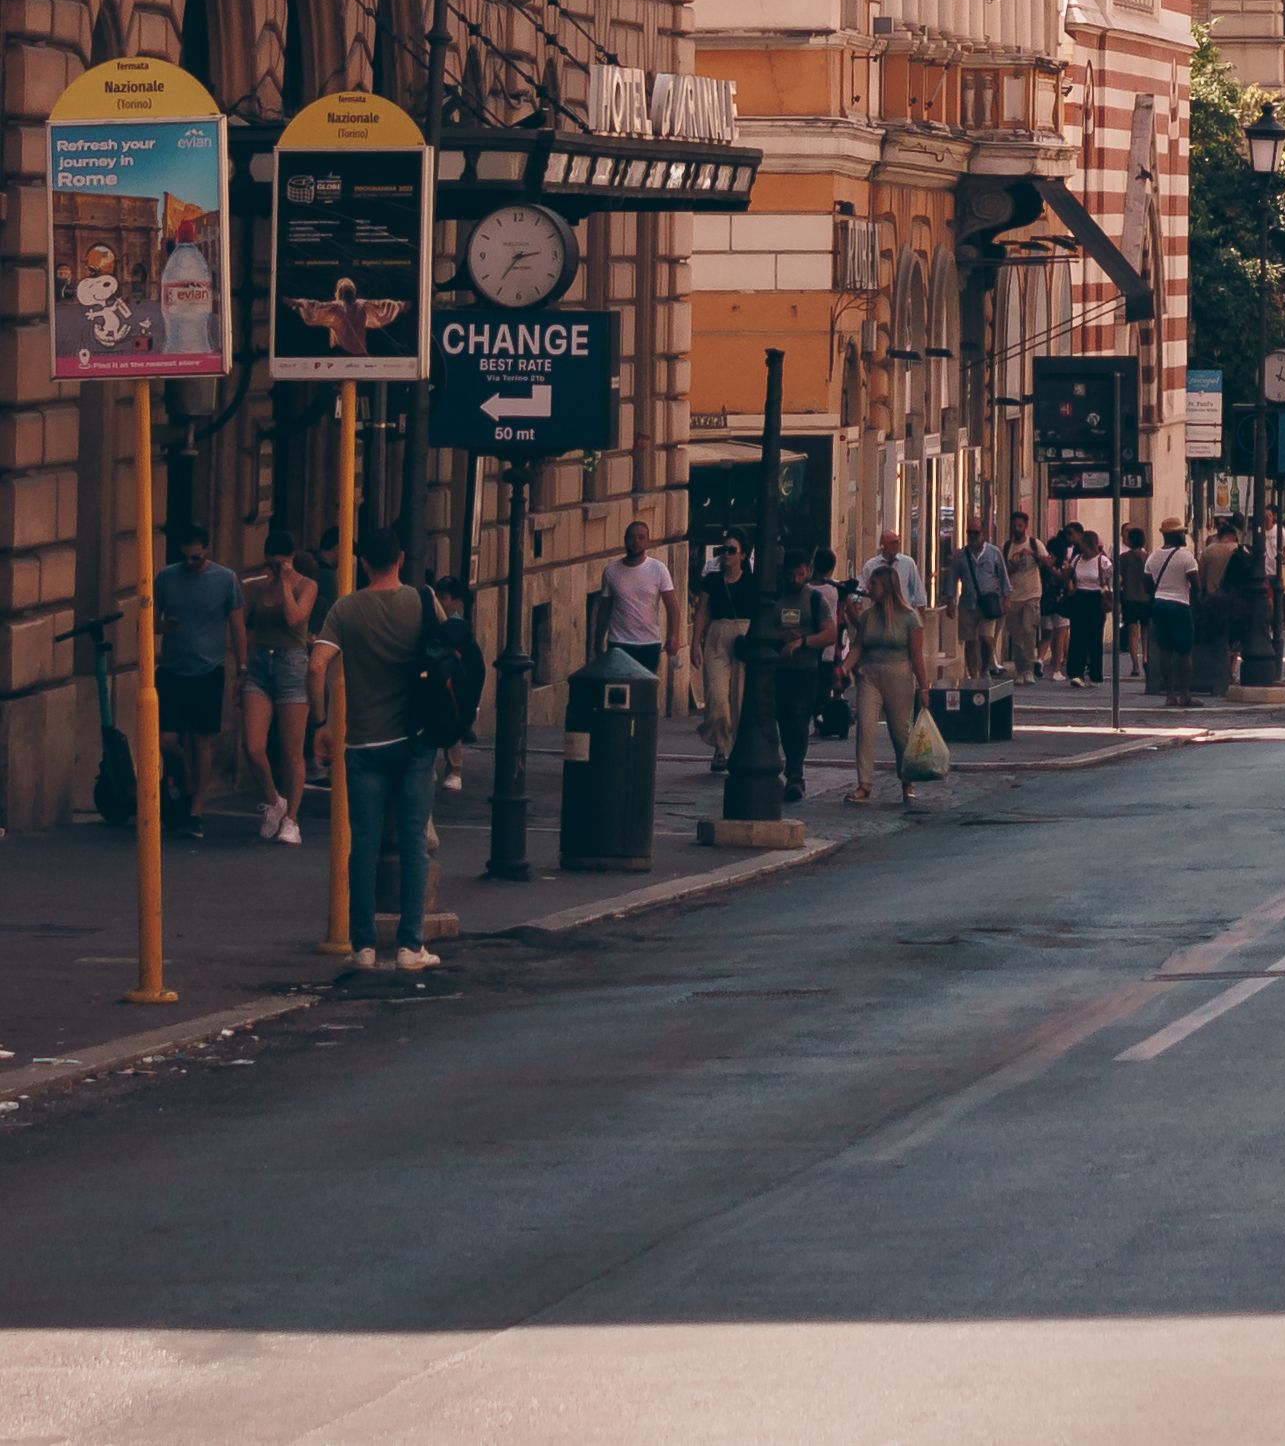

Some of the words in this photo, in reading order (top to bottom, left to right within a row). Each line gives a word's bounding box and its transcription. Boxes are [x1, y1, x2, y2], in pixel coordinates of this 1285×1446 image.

[117, 62, 149, 70] fermata
[104, 80, 165, 93] Nazionale
[117, 98, 152, 110] (Torino)
[590, 64, 652, 137] HOTEL
[327, 112, 380, 123] Nazionale
[337, 128, 369, 138] (Torino)
[56, 139, 118, 152] Refresh
[122, 139, 156, 152] your
[177, 136, 212, 149] evian
[58, 156, 117, 170] journey
[120, 155, 134, 166] in
[57, 172, 118, 187] Rome
[513, 213, 524, 222] 12
[177, 289, 209, 301] evian
[442, 323, 590, 356] CHANGE
[480, 359, 513, 371] BEST
[518, 359, 552, 371] RATE
[494, 427, 513, 440] 50
[516, 427, 535, 440] mt
